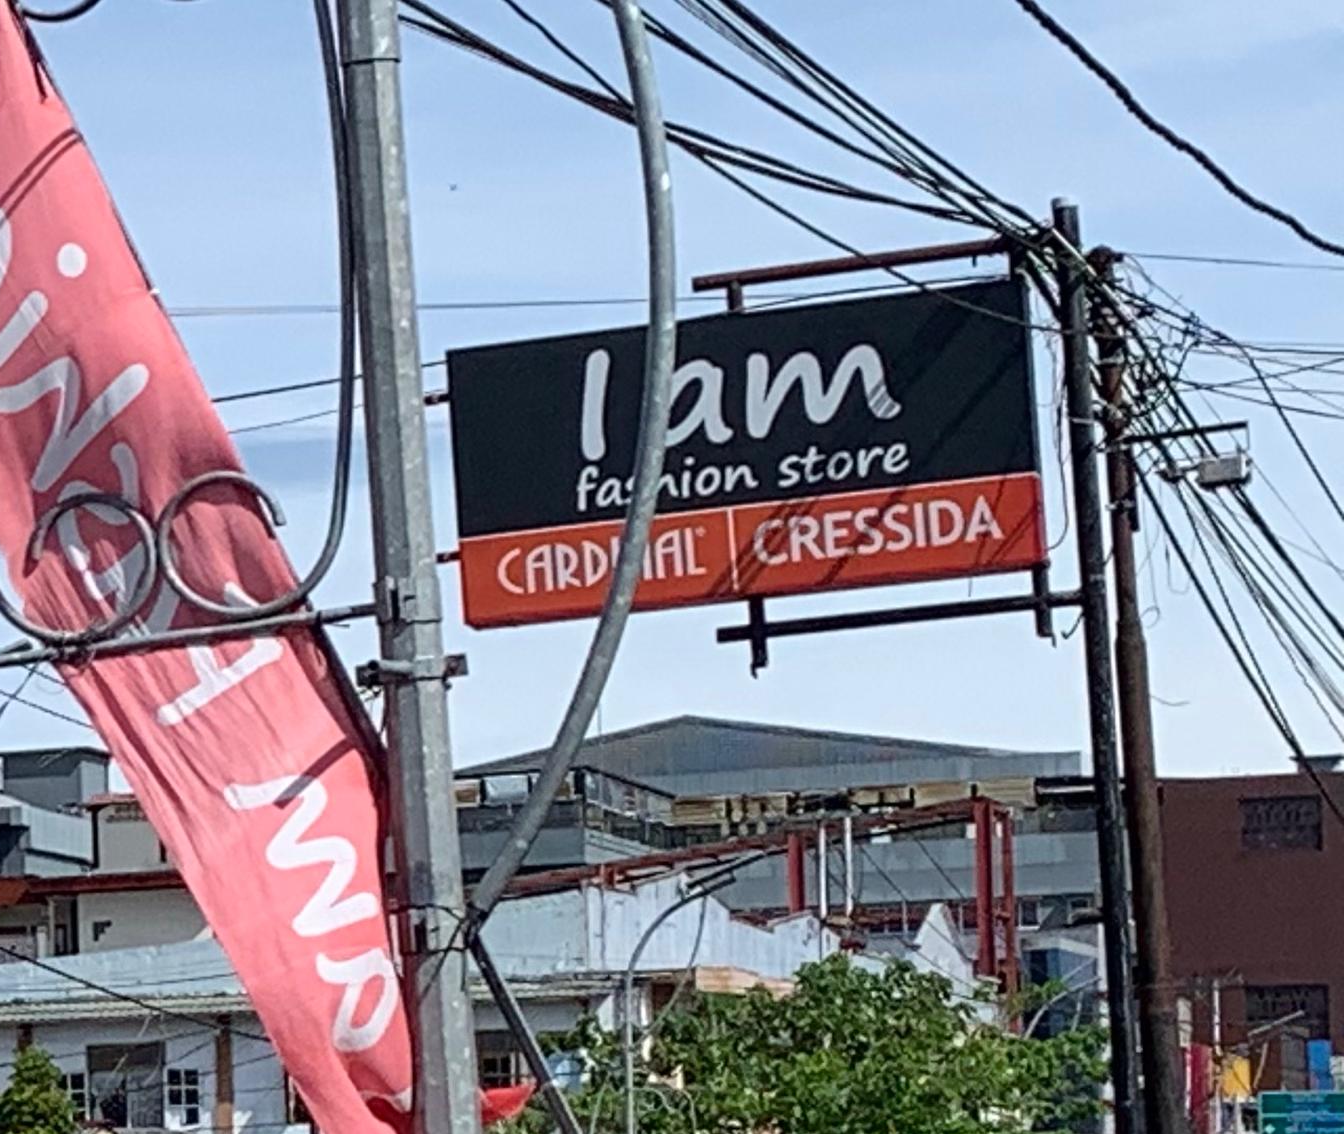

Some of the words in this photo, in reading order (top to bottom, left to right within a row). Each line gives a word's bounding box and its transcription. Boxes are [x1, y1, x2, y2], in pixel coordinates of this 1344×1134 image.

[581, 348, 611, 462] I
[664, 344, 902, 446] am
[777, 442, 911, 488] store
[753, 494, 1005, 566] CRESSIDA
